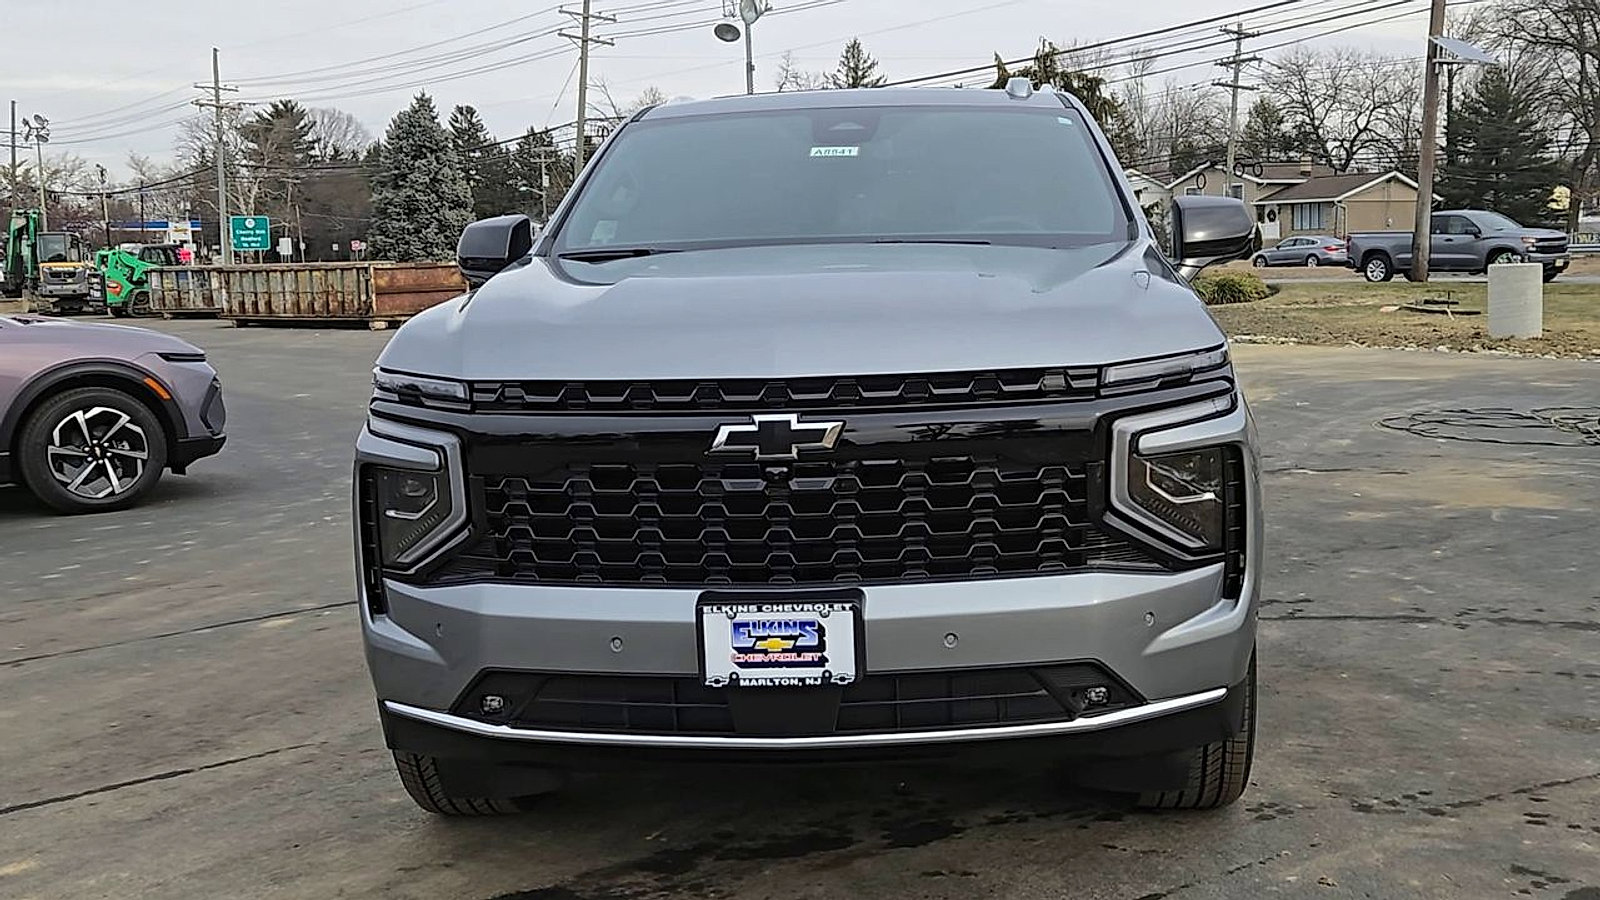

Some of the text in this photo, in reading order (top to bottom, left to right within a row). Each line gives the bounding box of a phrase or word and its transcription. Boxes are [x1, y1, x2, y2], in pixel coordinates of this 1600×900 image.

[703, 603, 853, 613] ELKINS CHEVROLET
[732, 619, 819, 647] ELKINS
[731, 653, 822, 663] CHEVROLET
[739, 677, 822, 687] MARLTON, NJ
